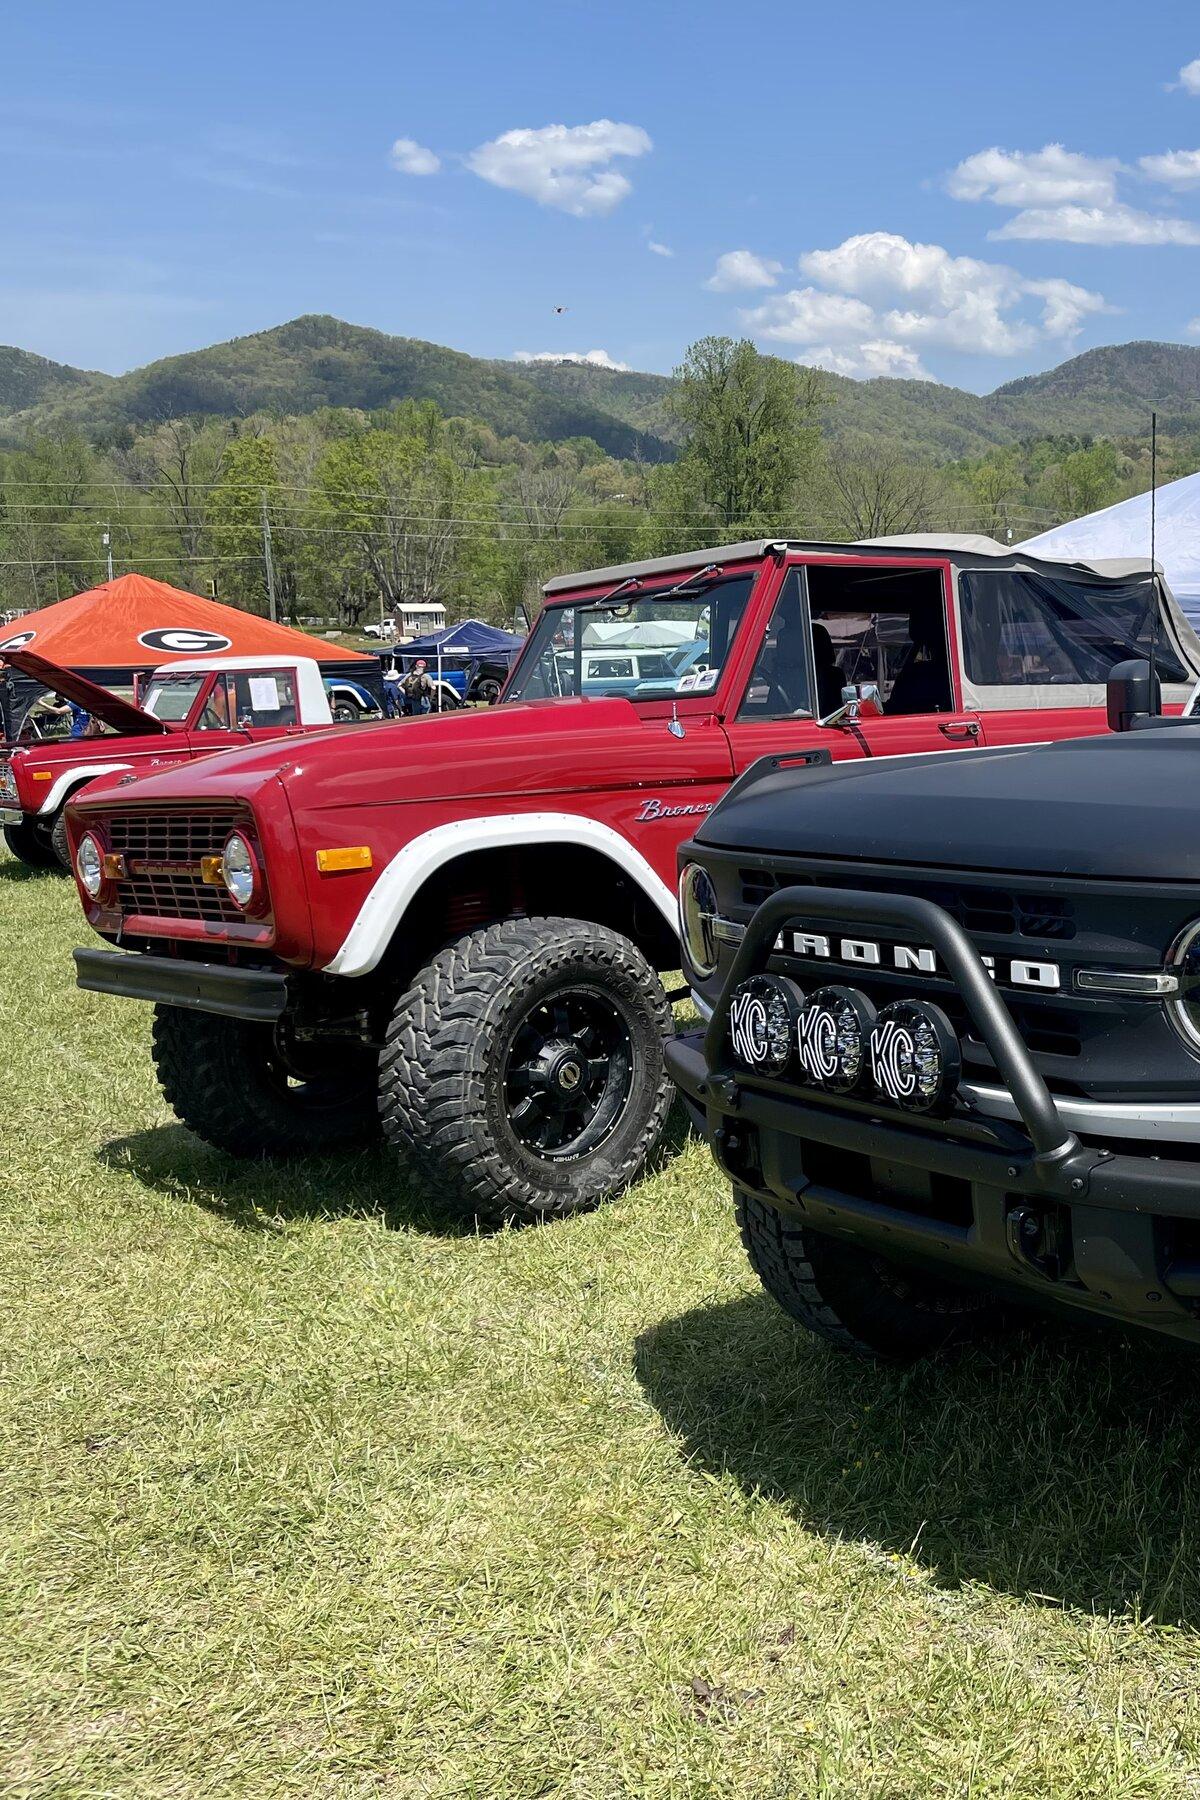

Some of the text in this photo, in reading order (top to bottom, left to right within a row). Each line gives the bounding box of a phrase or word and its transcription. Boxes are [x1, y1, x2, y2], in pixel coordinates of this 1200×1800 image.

[634, 799, 713, 821] Bronco
[773, 929, 1061, 988] RONO
[730, 992, 768, 1064] KC
[797, 1005, 838, 1080] KC
[870, 1020, 916, 1099] KC
